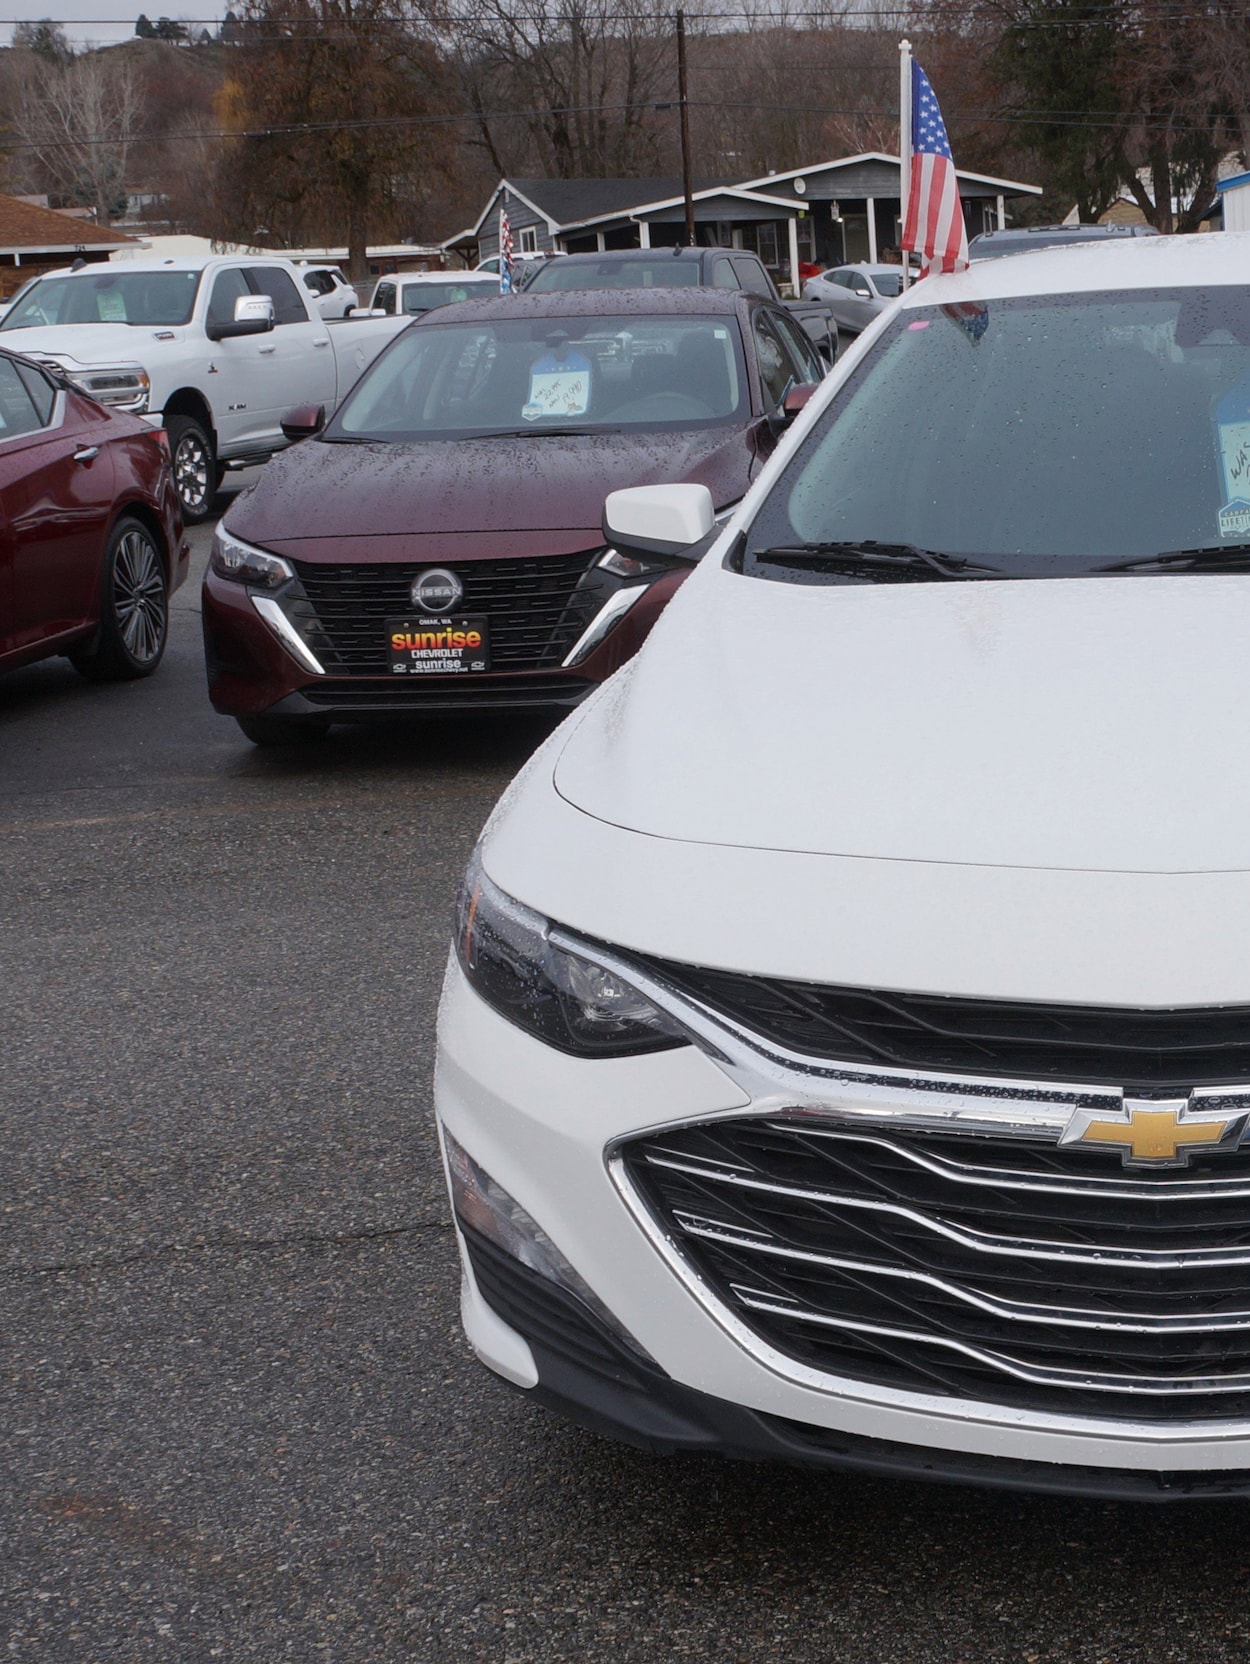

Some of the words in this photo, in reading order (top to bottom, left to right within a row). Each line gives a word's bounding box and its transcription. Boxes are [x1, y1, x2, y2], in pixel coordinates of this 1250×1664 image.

[411, 588, 462, 597] NISSAN
[391, 627, 481, 650] sunrise
[411, 648, 464, 659] CHEVROLET
[415, 658, 461, 669] sunrise
